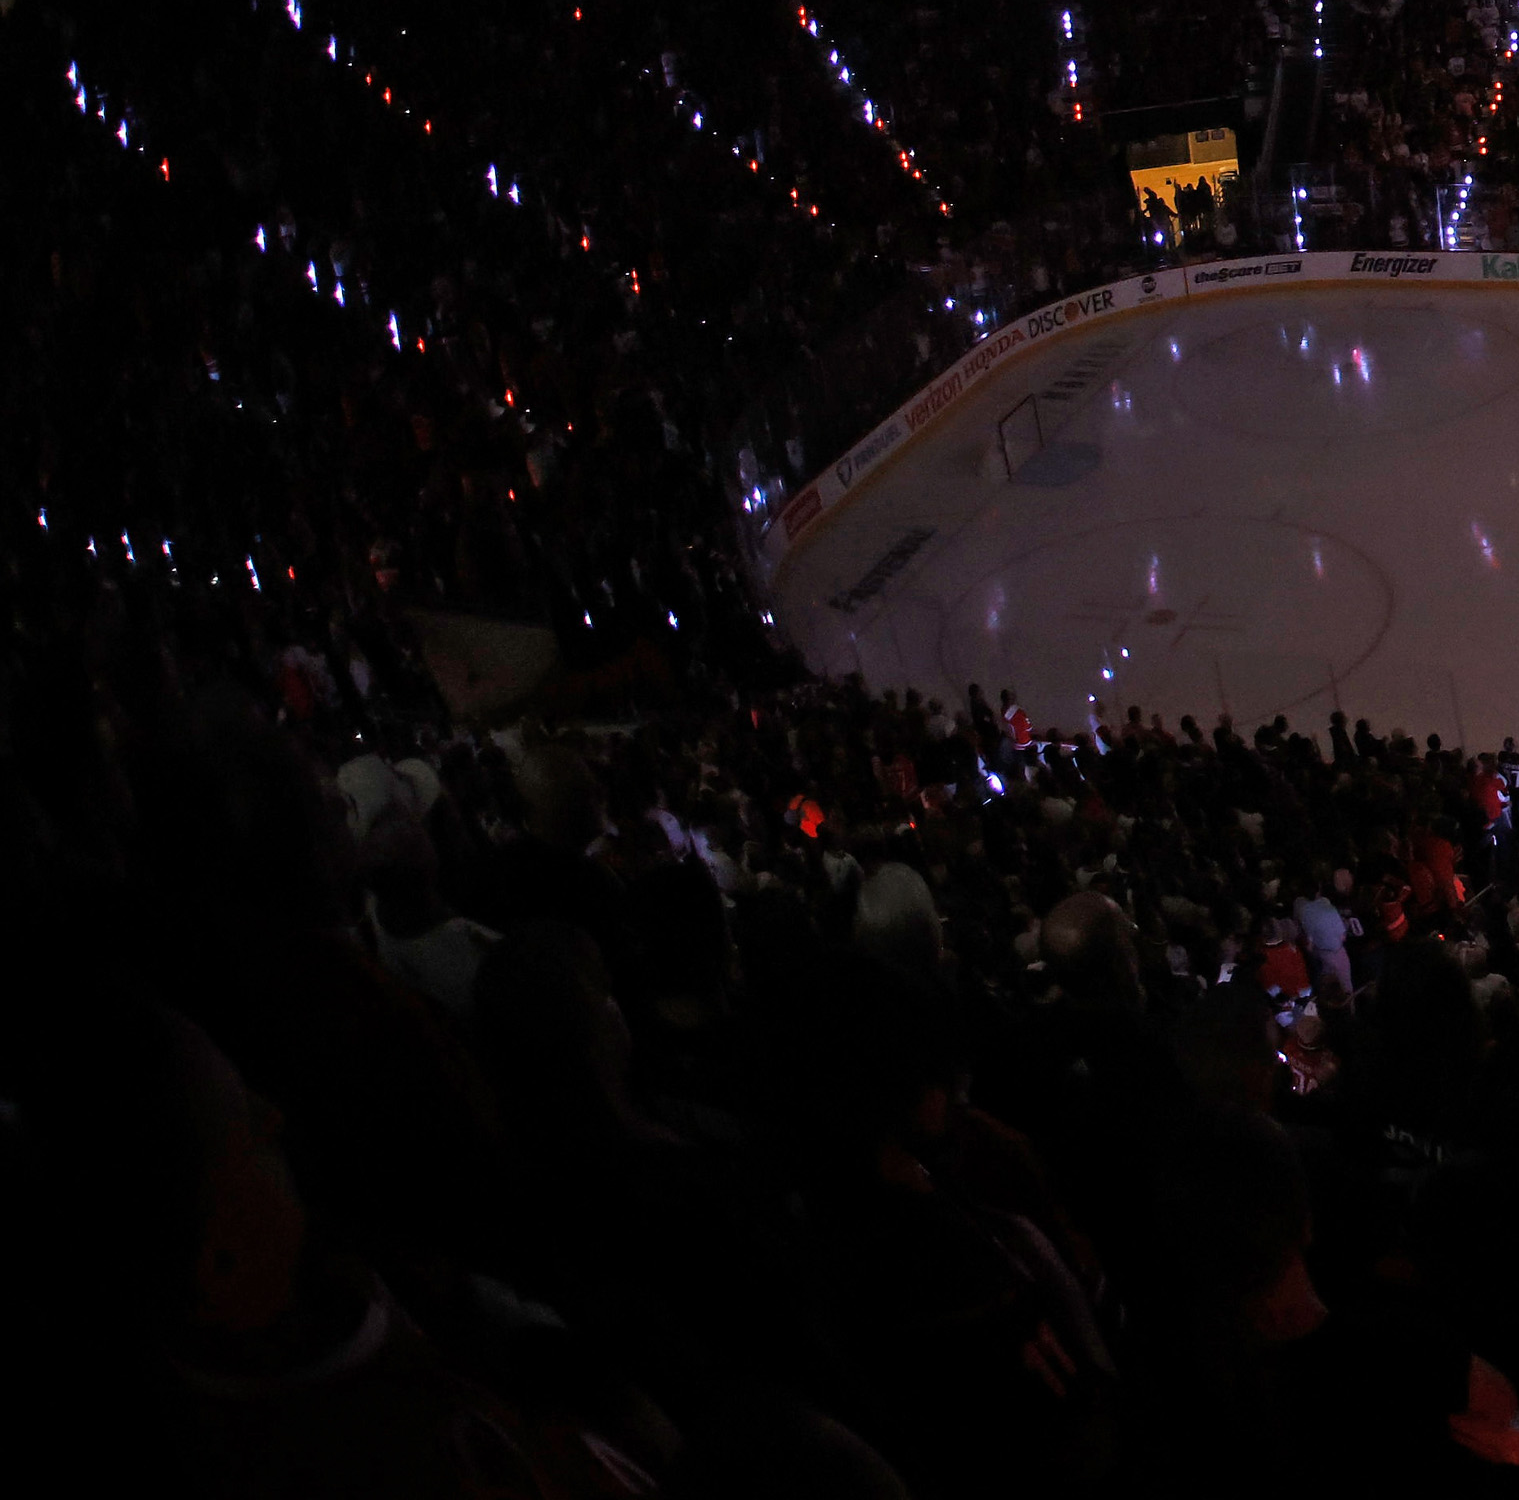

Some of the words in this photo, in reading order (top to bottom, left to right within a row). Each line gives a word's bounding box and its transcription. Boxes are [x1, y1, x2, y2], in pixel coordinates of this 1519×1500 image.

[1194, 265, 1264, 284] theScore
[1349, 252, 1437, 277] Energizer
[963, 329, 1026, 381] HONDA
[904, 372, 963, 434] verizon
